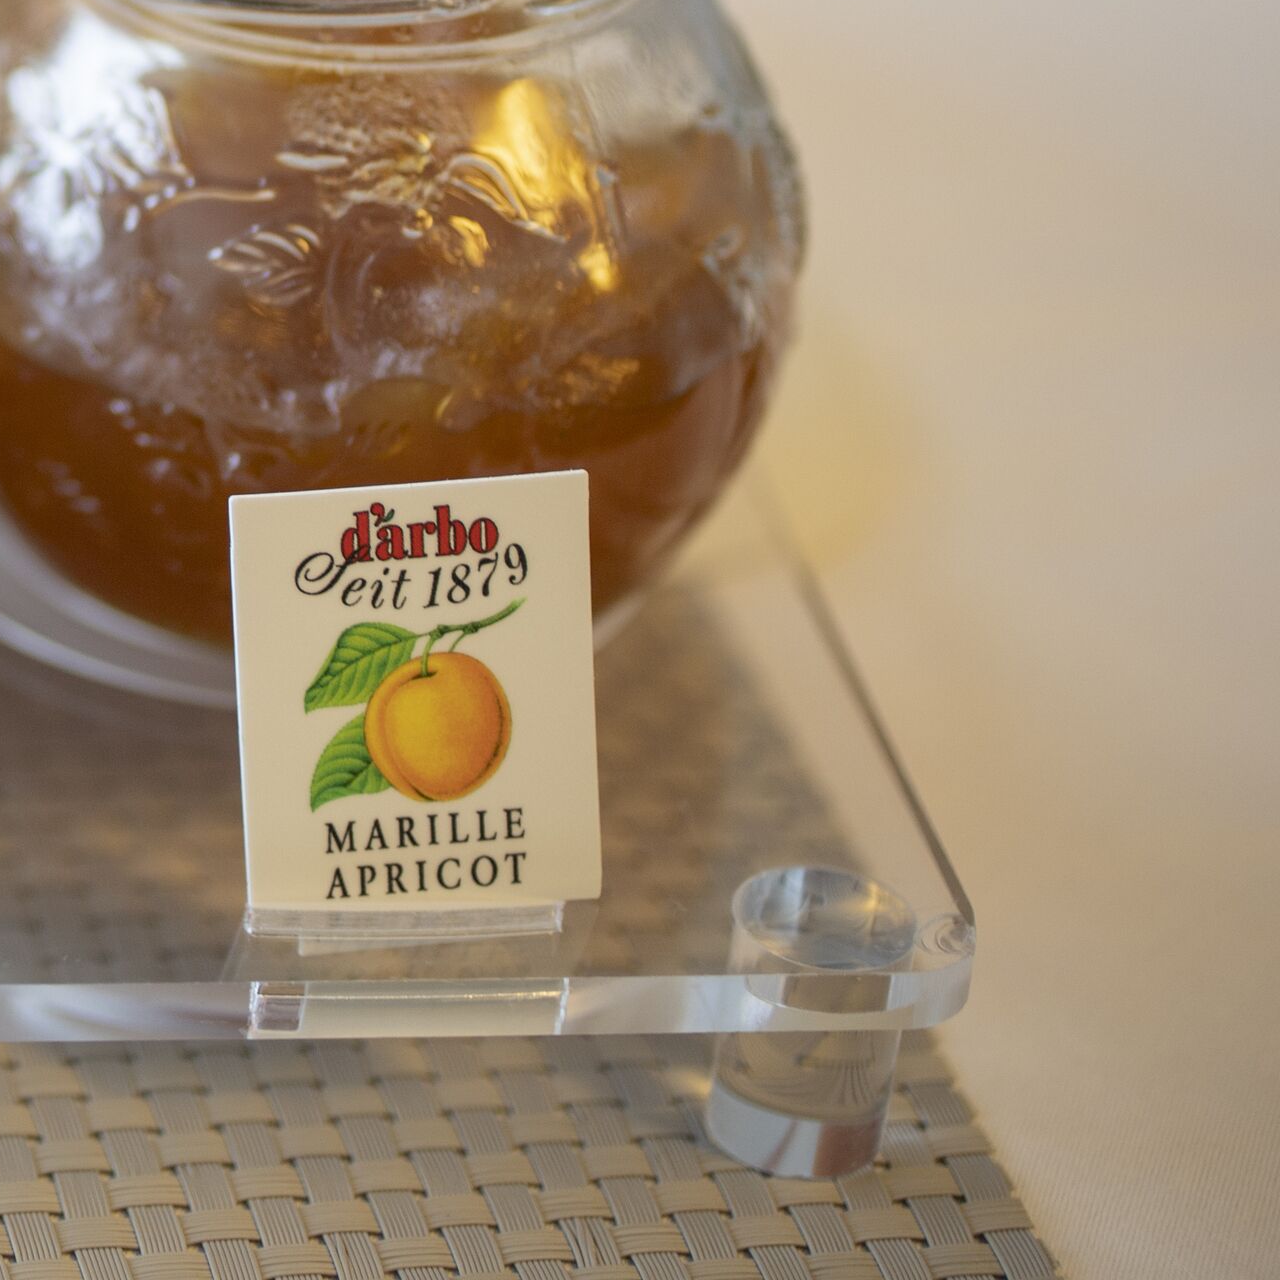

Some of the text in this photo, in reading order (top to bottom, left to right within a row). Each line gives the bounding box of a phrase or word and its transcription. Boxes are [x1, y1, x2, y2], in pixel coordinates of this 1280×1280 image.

[294, 542, 529, 610] Seit 1879
[325, 807, 527, 854] MARILLE
[325, 851, 527, 900] APRICOT
